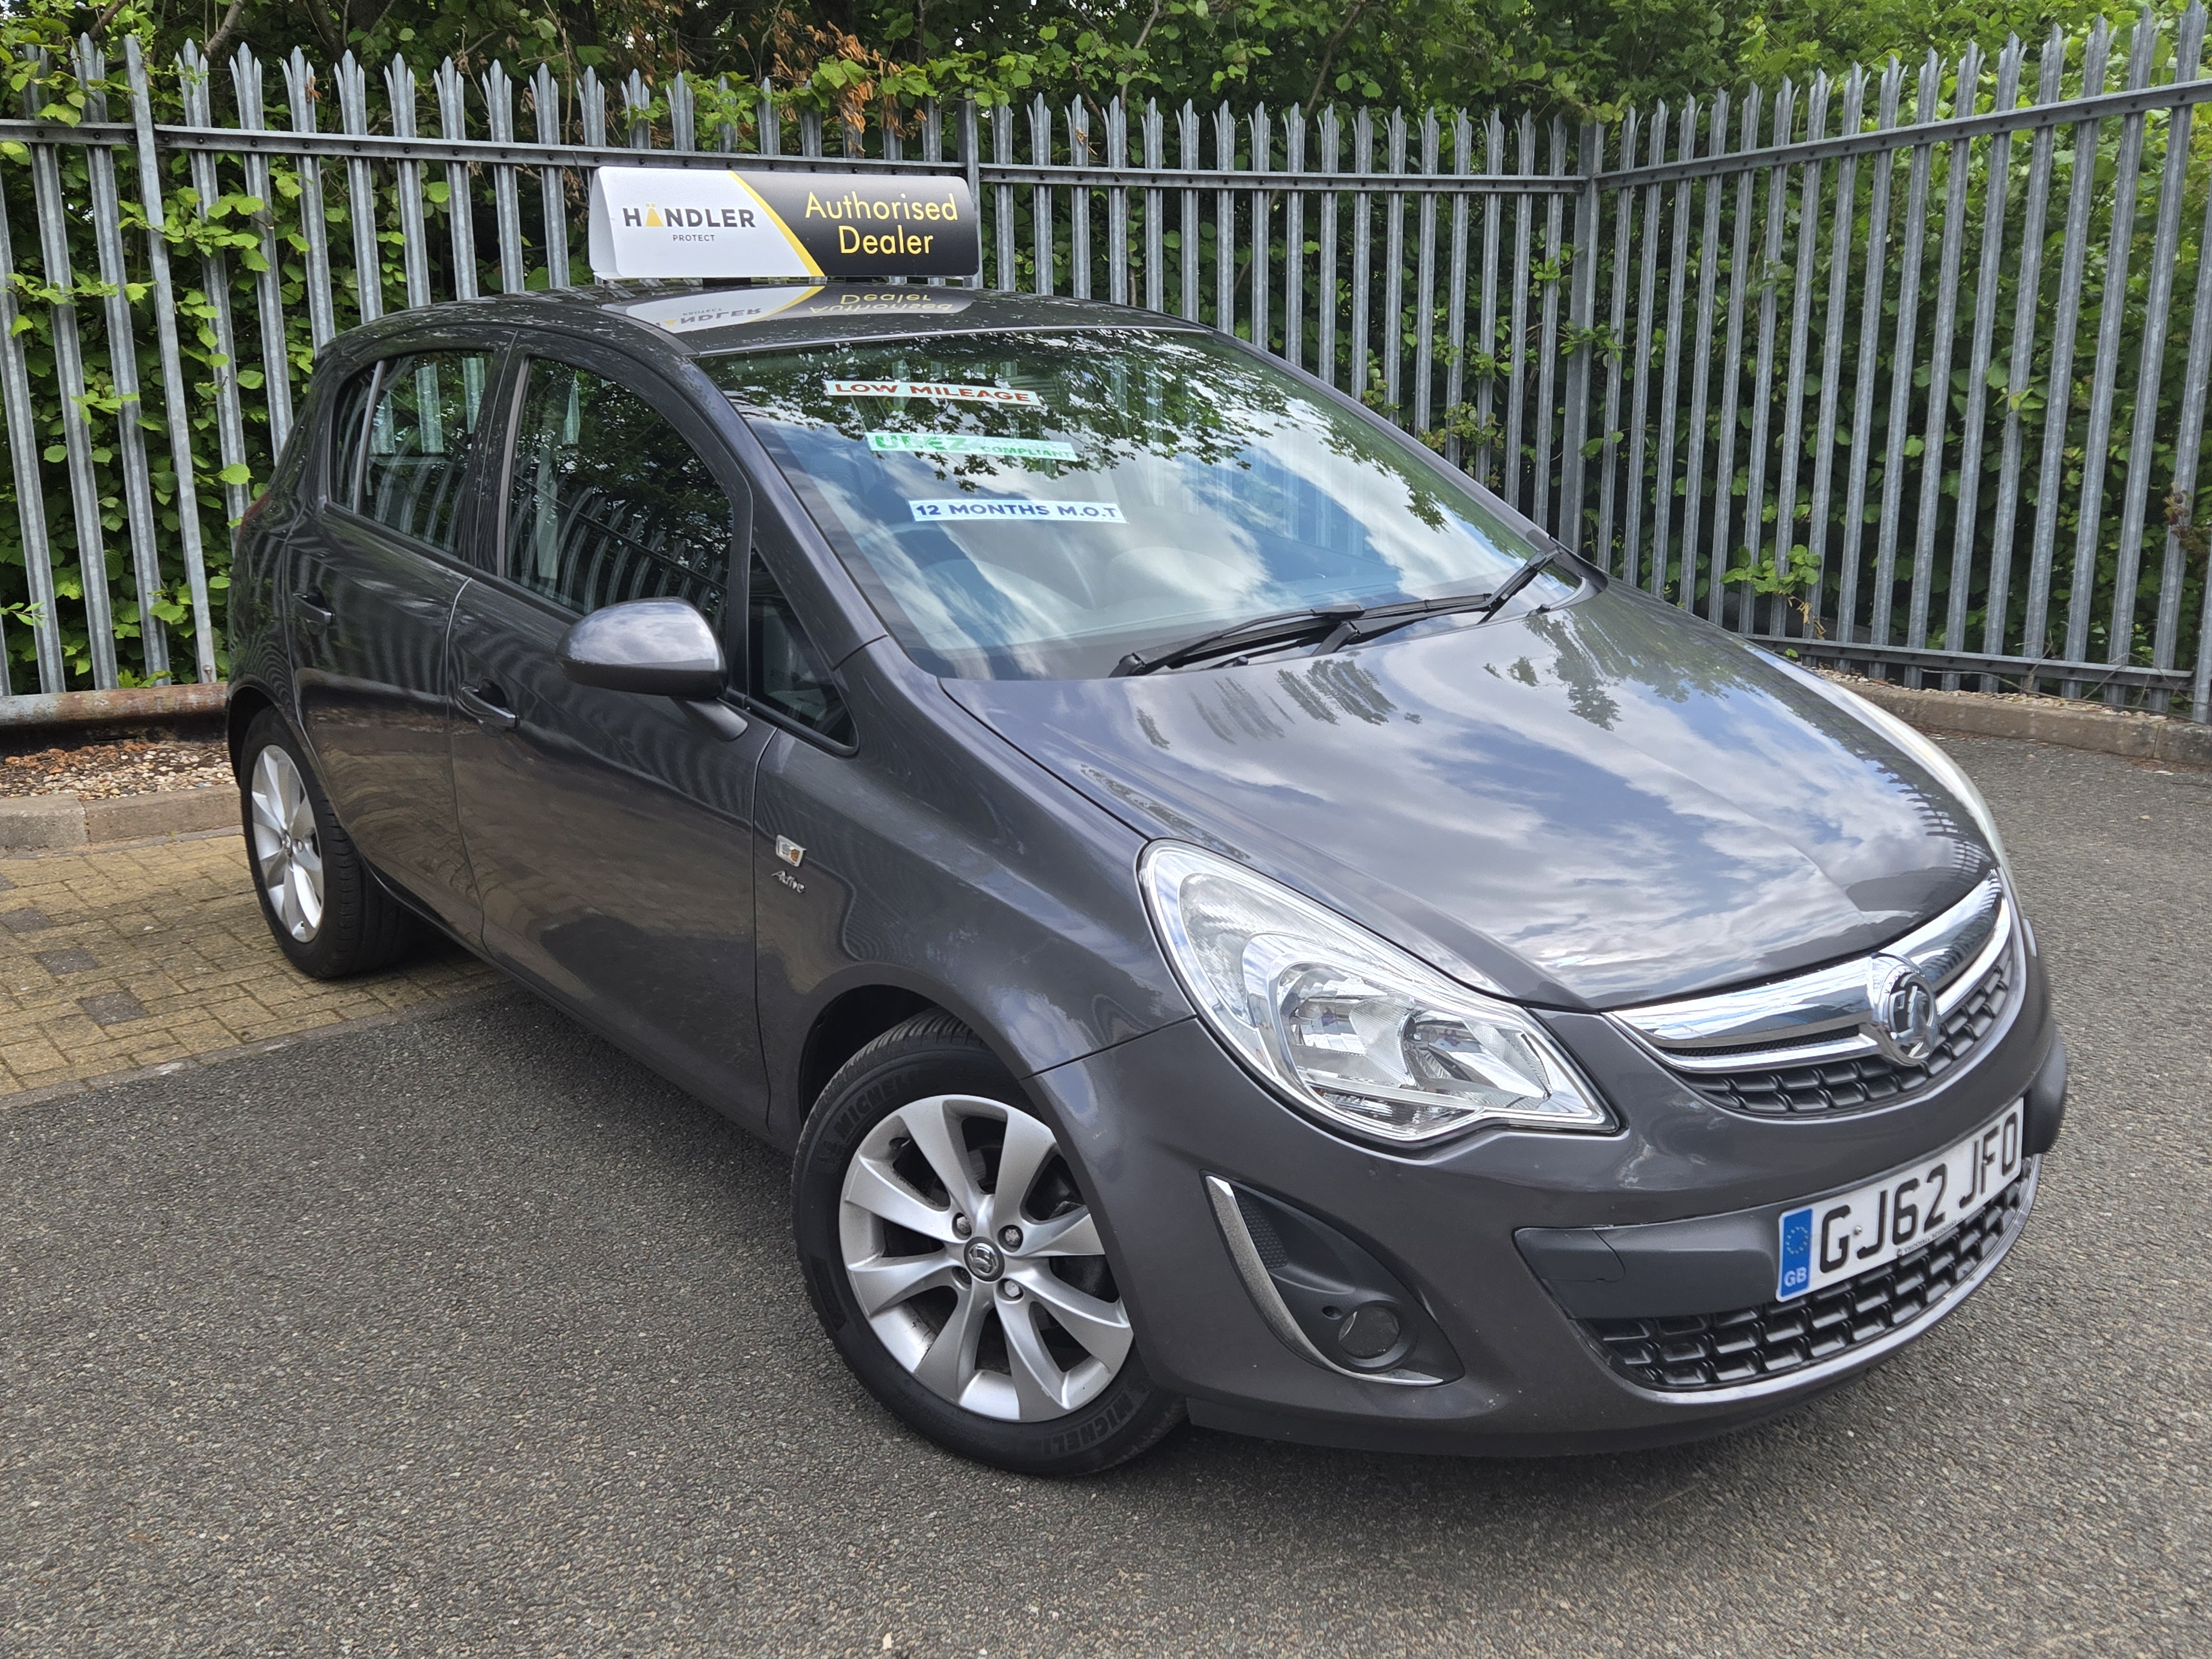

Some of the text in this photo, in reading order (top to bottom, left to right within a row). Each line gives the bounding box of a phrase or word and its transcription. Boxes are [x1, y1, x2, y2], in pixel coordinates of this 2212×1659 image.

[805, 191, 958, 221] Authorised
[673, 234, 716, 242] PROTECT
[839, 225, 933, 254] Dealer
[835, 383, 1031, 403] LOW MILEAGE
[980, 445, 1073, 460] COMPLIANT
[916, 504, 941, 516] 12
[950, 503, 1050, 516] MONTHS
[1819, 1111, 2019, 1274] GJ62 JFO
[1783, 1266, 1807, 1287] GB
